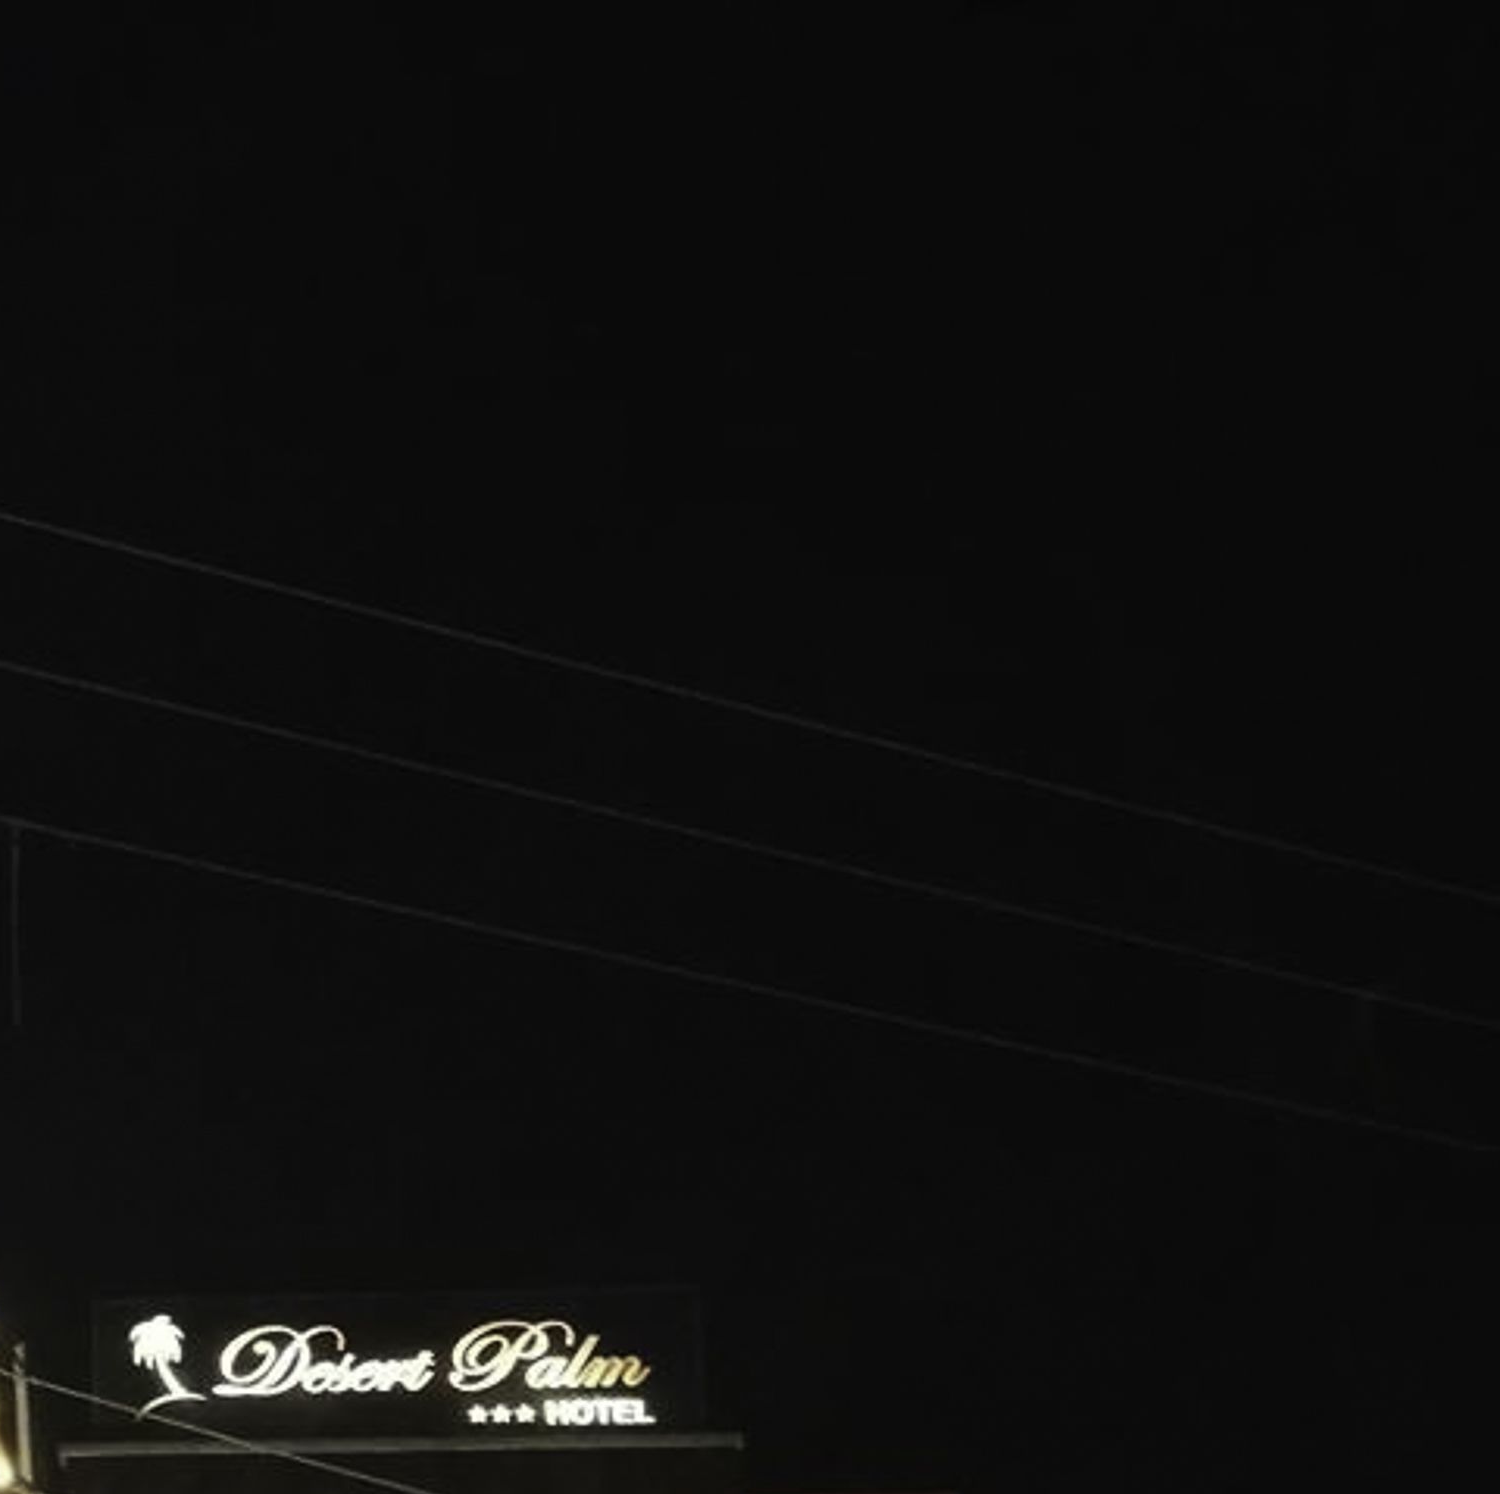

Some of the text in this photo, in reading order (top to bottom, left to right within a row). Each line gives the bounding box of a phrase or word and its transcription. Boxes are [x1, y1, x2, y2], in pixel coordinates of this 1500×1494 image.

[212, 1320, 650, 1397] Desert Palm
[544, 1396, 656, 1426] HOTEL
